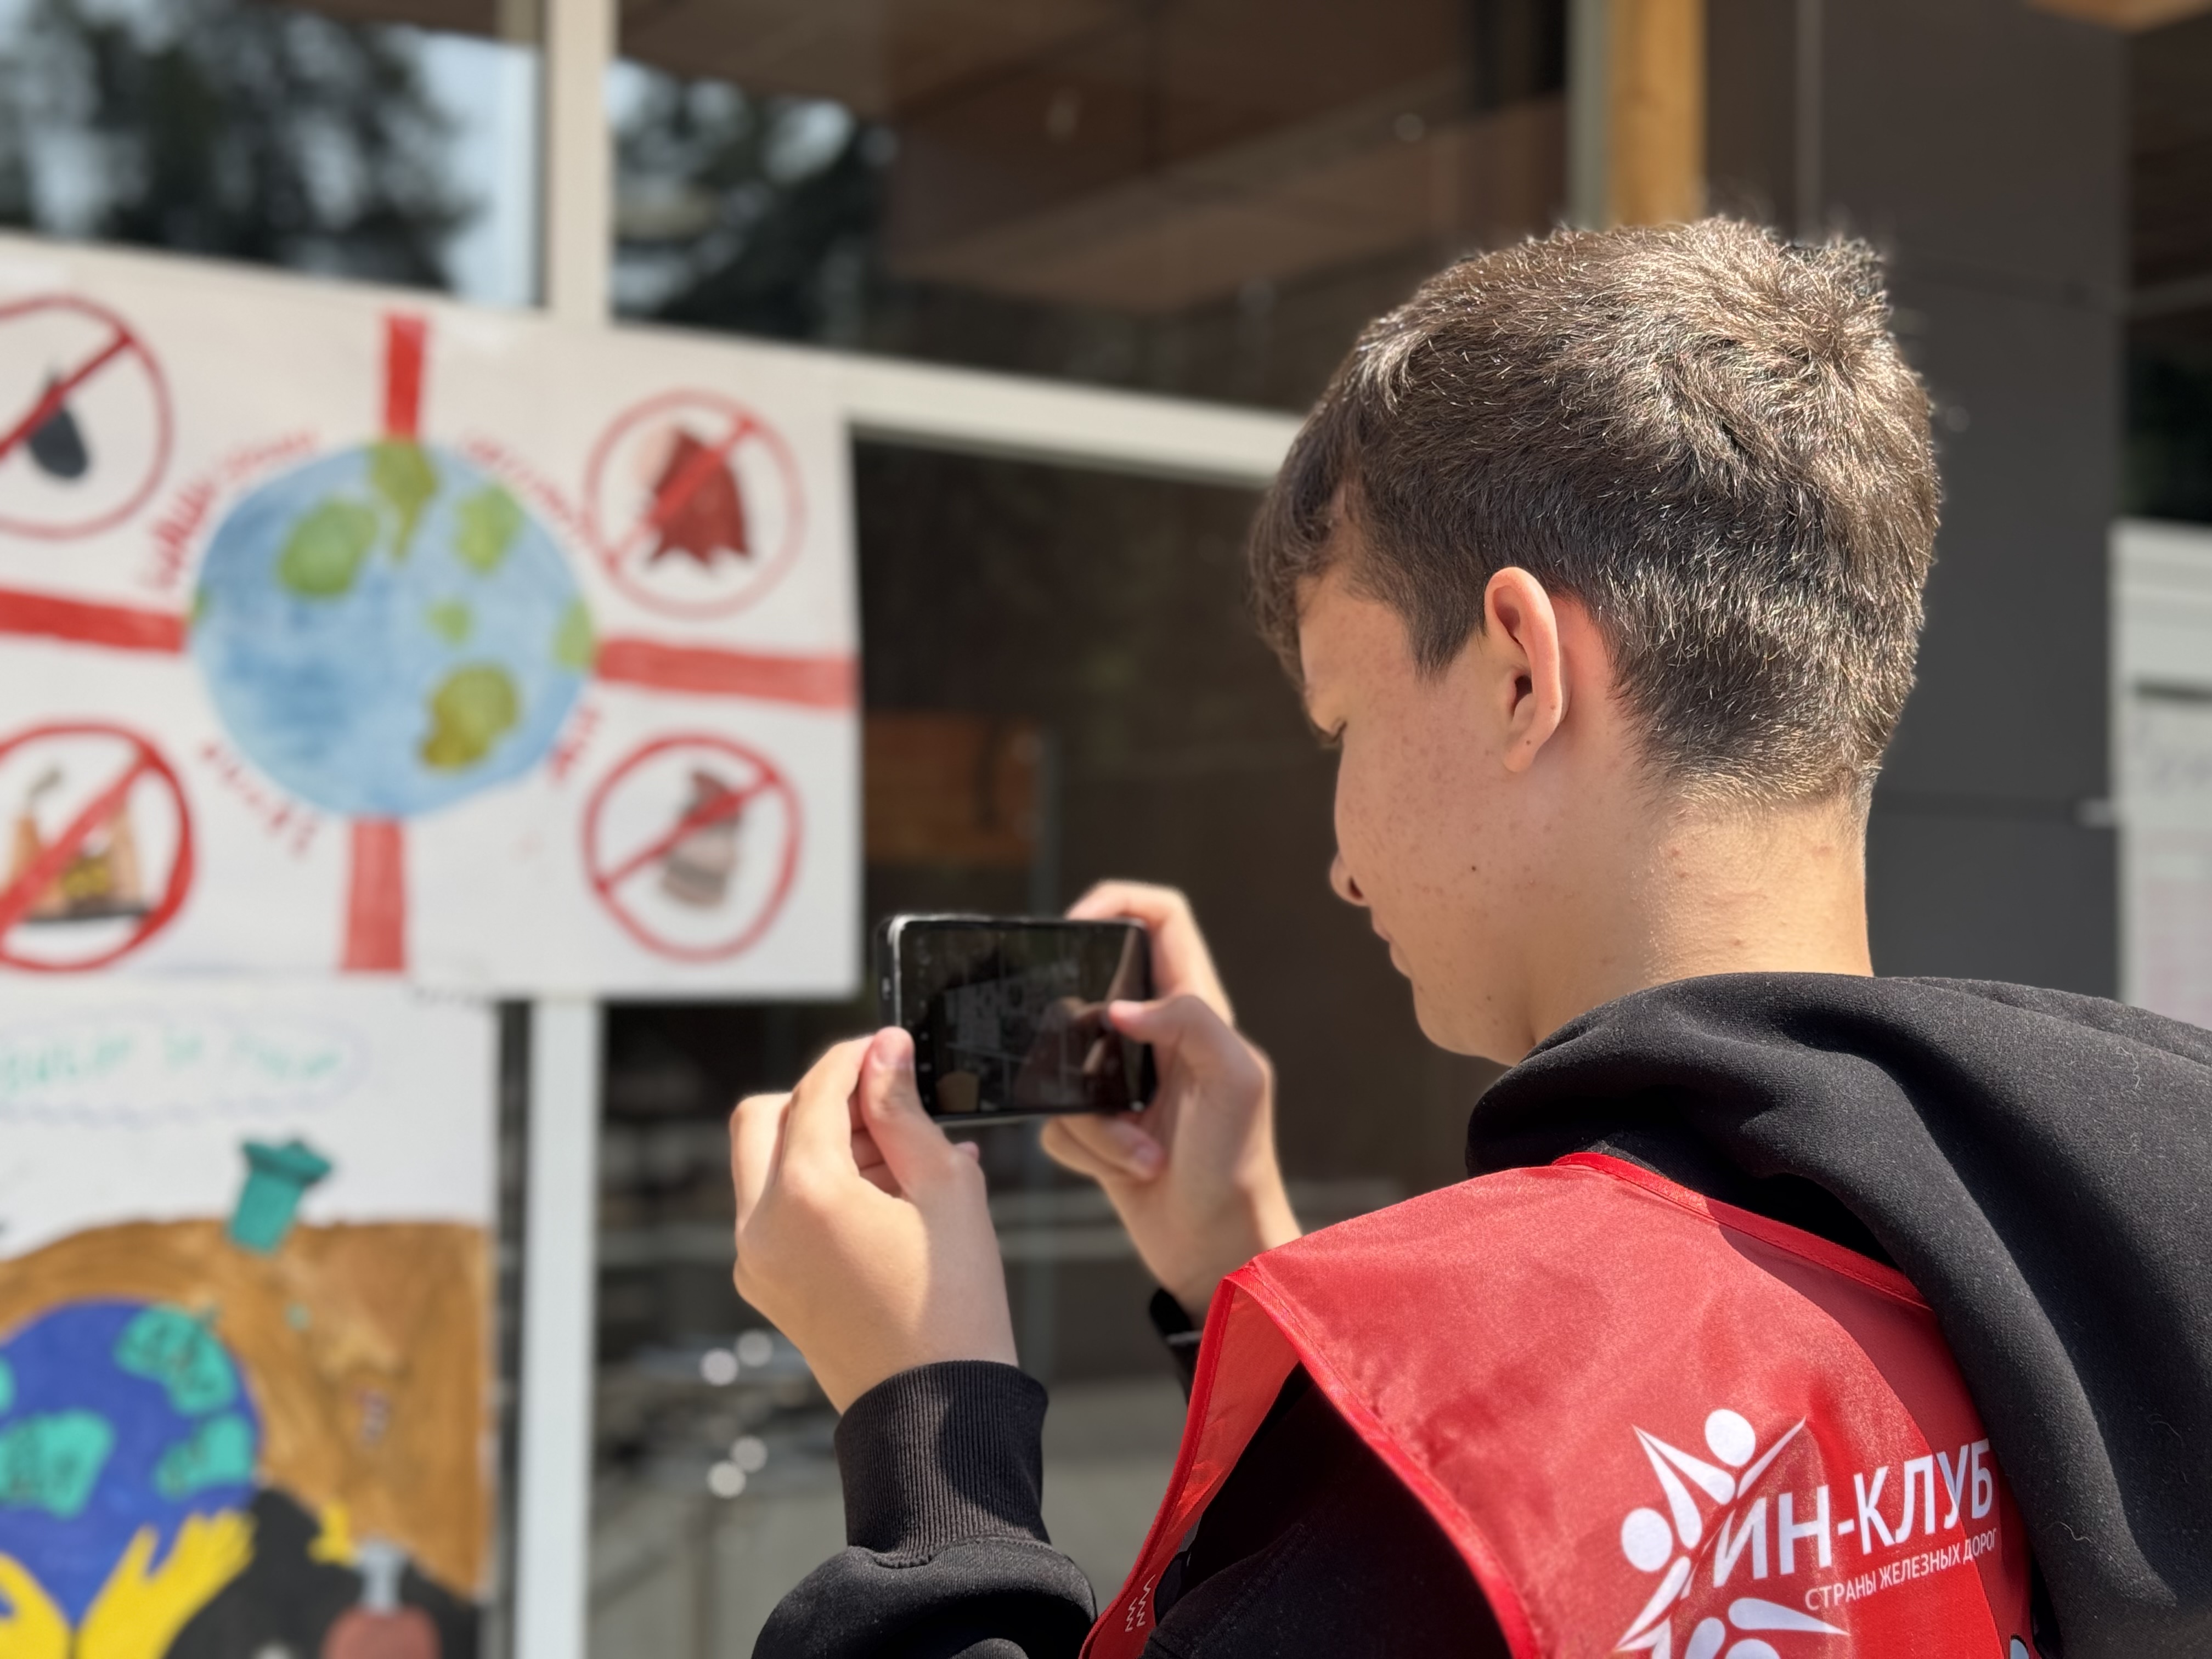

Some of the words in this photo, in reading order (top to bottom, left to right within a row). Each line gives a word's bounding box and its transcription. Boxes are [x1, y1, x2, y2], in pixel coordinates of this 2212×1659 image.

[1713, 1438, 1993, 1588] ИН-КЛУБ
[1804, 1571, 1876, 1611] СТРАНЫ
[1878, 1544, 1960, 1589] ЖЕЛЕЗНЫХ
[1962, 1528, 1997, 1565] ДОРОГ
